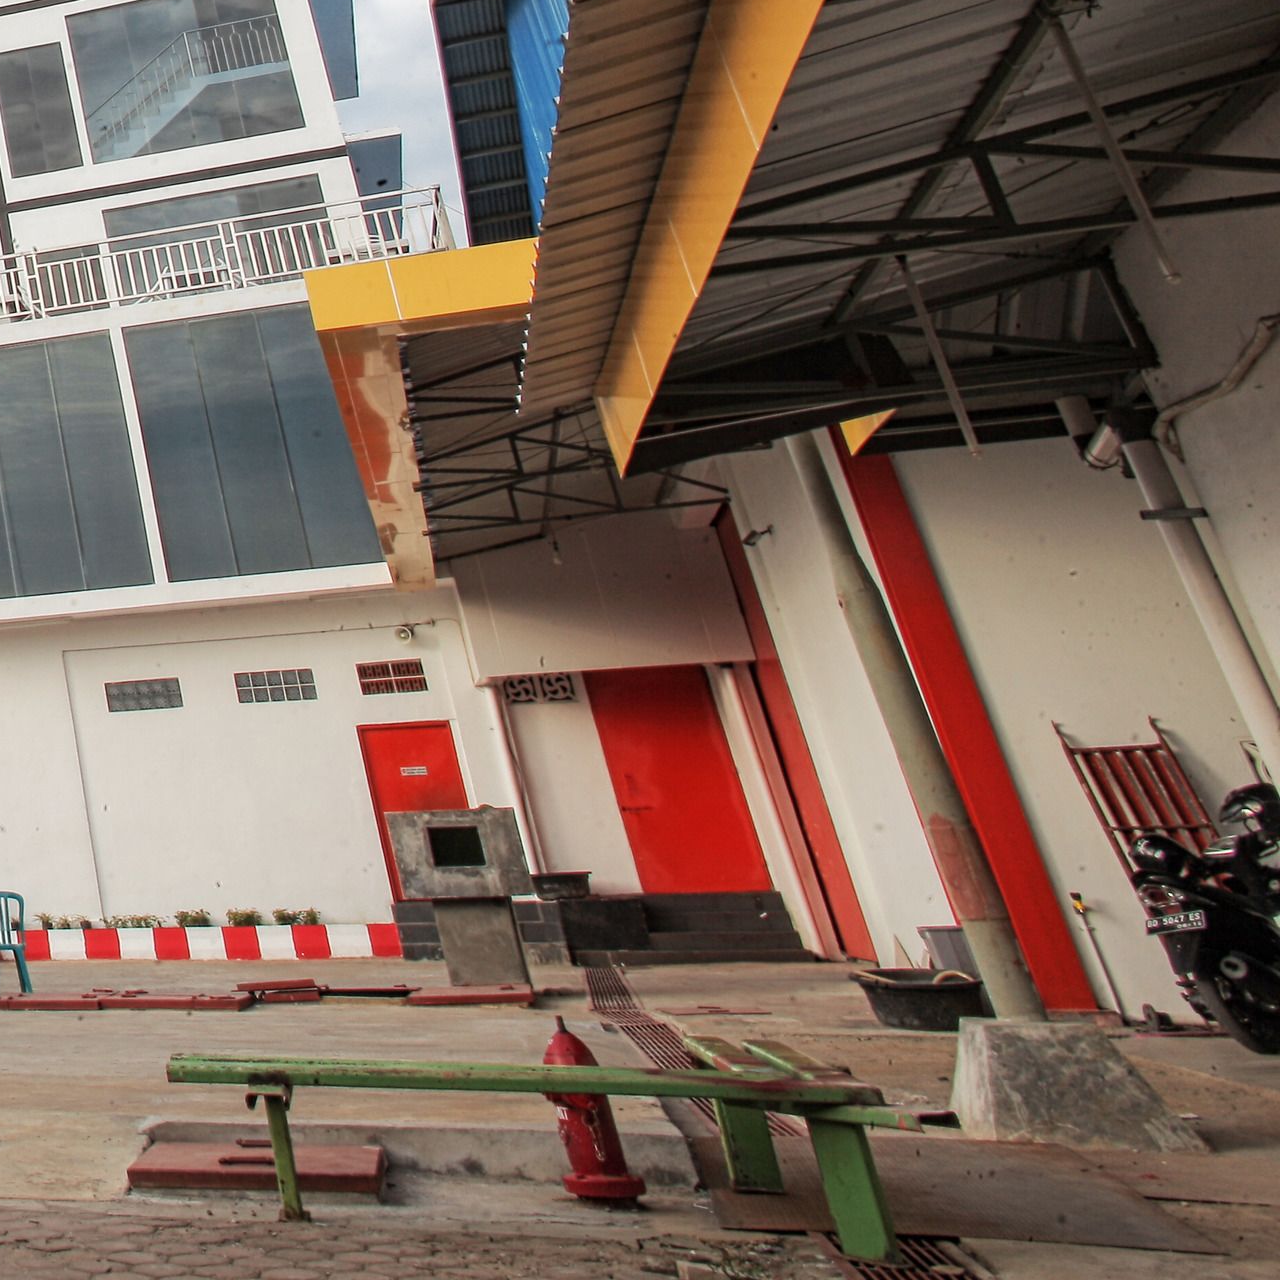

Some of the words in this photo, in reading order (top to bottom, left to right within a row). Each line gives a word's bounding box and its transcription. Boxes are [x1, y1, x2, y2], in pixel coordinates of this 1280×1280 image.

[1147, 920, 1158, 928] BD
[1162, 915, 1184, 926] 5047
[1188, 912, 1200, 921] ES
